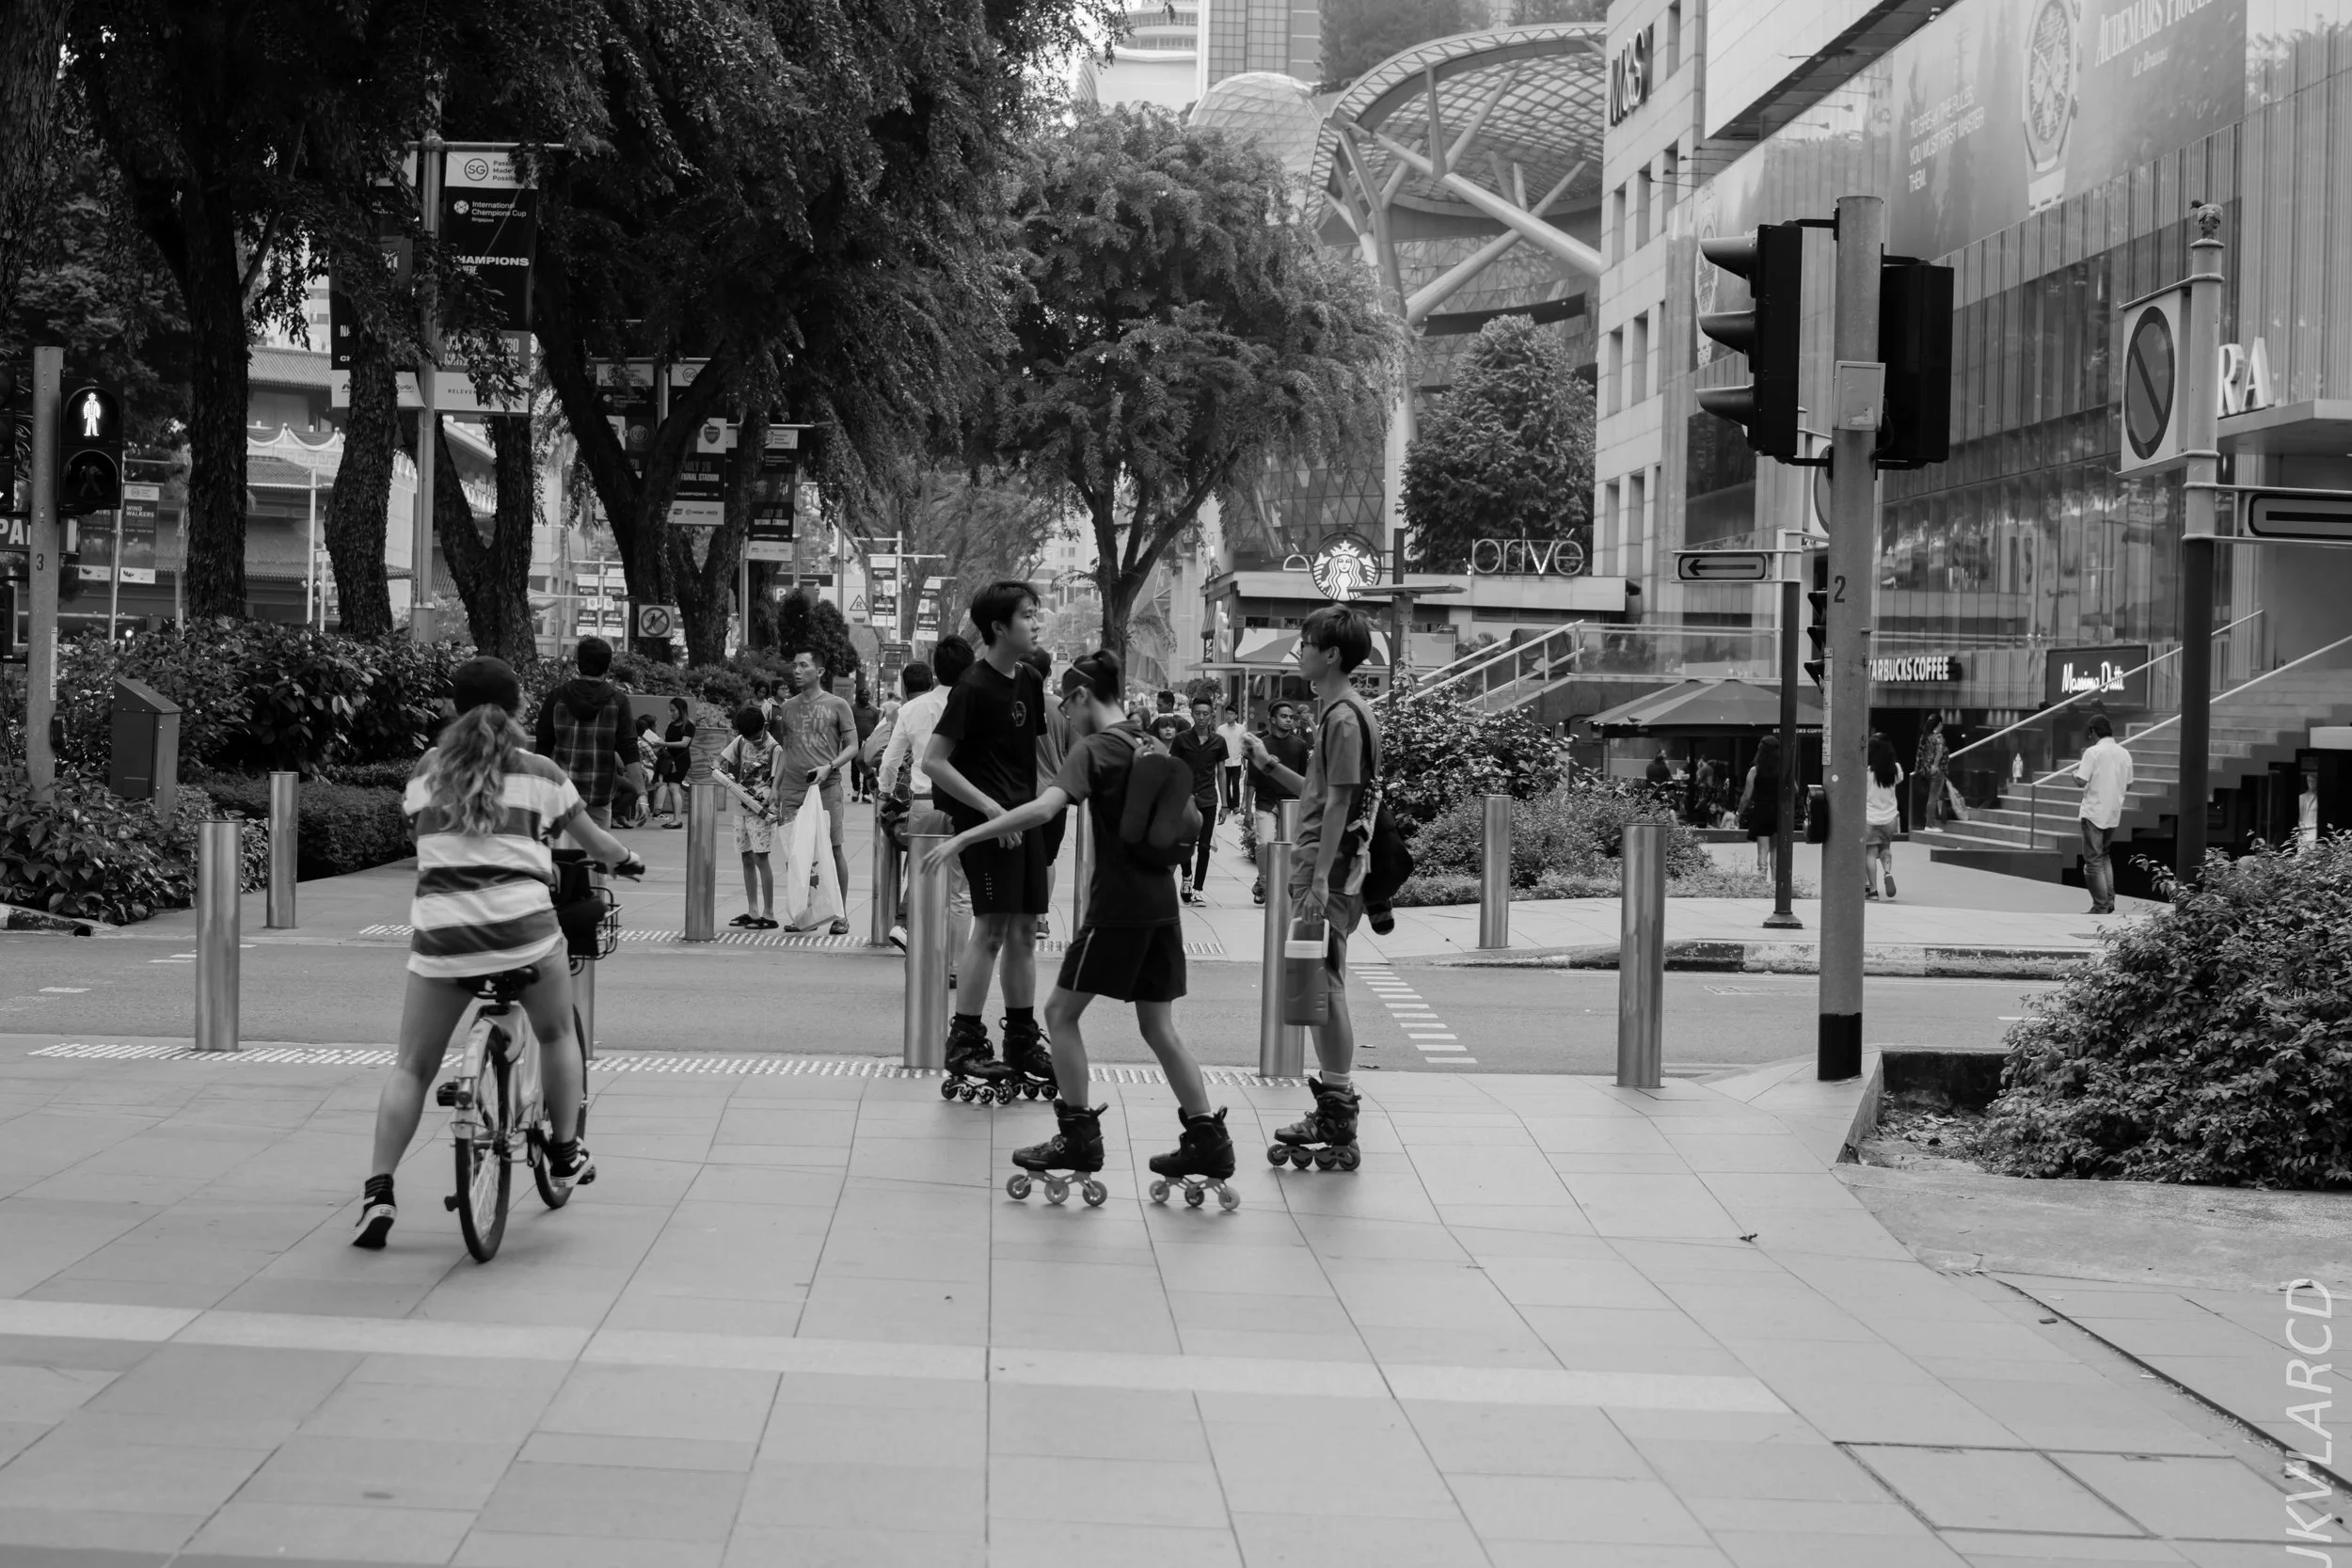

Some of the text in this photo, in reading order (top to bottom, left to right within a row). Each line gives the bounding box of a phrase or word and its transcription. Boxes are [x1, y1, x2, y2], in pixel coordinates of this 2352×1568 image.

[2094, 0, 2163, 68] AUDEMARS
[1610, 27, 1650, 123] M&S
[1910, 85, 1975, 139] TO BREAK THE RULES
[1910, 106, 1984, 166] YOU MUST FIRST MASTER
[468, 165, 485, 175] SG
[471, 200, 516, 209] International
[471, 208, 527, 218] Champions Cup
[452, 255, 530, 266] HAMPIONS
[2217, 337, 2271, 416] RA
[0, 518, 31, 546] PA
[36, 553, 44, 571] 3
[1471, 528, 1584, 577] privé
[1834, 575, 1847, 603] 2
[1913, 656, 1949, 681] COFFEE
